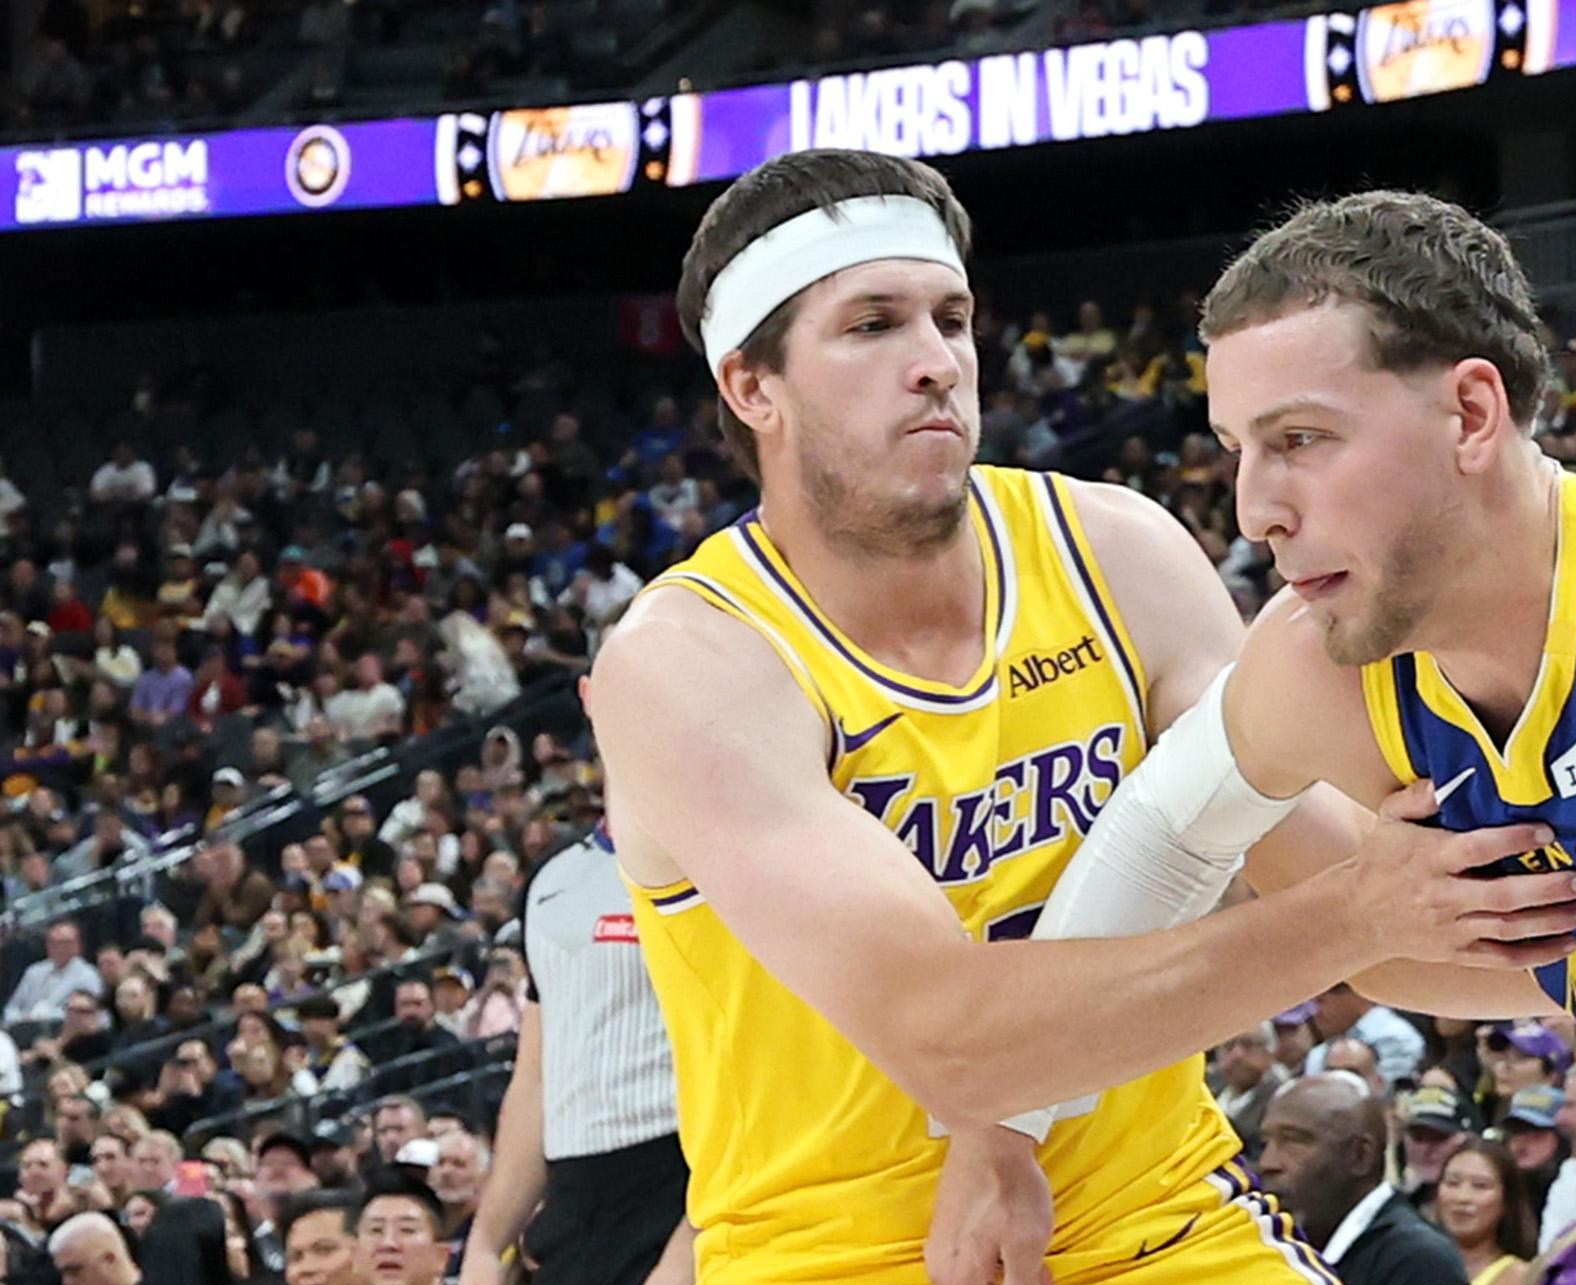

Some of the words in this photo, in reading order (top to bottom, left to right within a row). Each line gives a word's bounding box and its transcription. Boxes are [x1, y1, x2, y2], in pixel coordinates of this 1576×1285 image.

[790, 60, 972, 159] LAKERS
[978, 51, 1038, 150] IN
[1043, 31, 1209, 141] VEGAS
[85, 138, 208, 190] MGM
[1008, 635, 1103, 699] Albert
